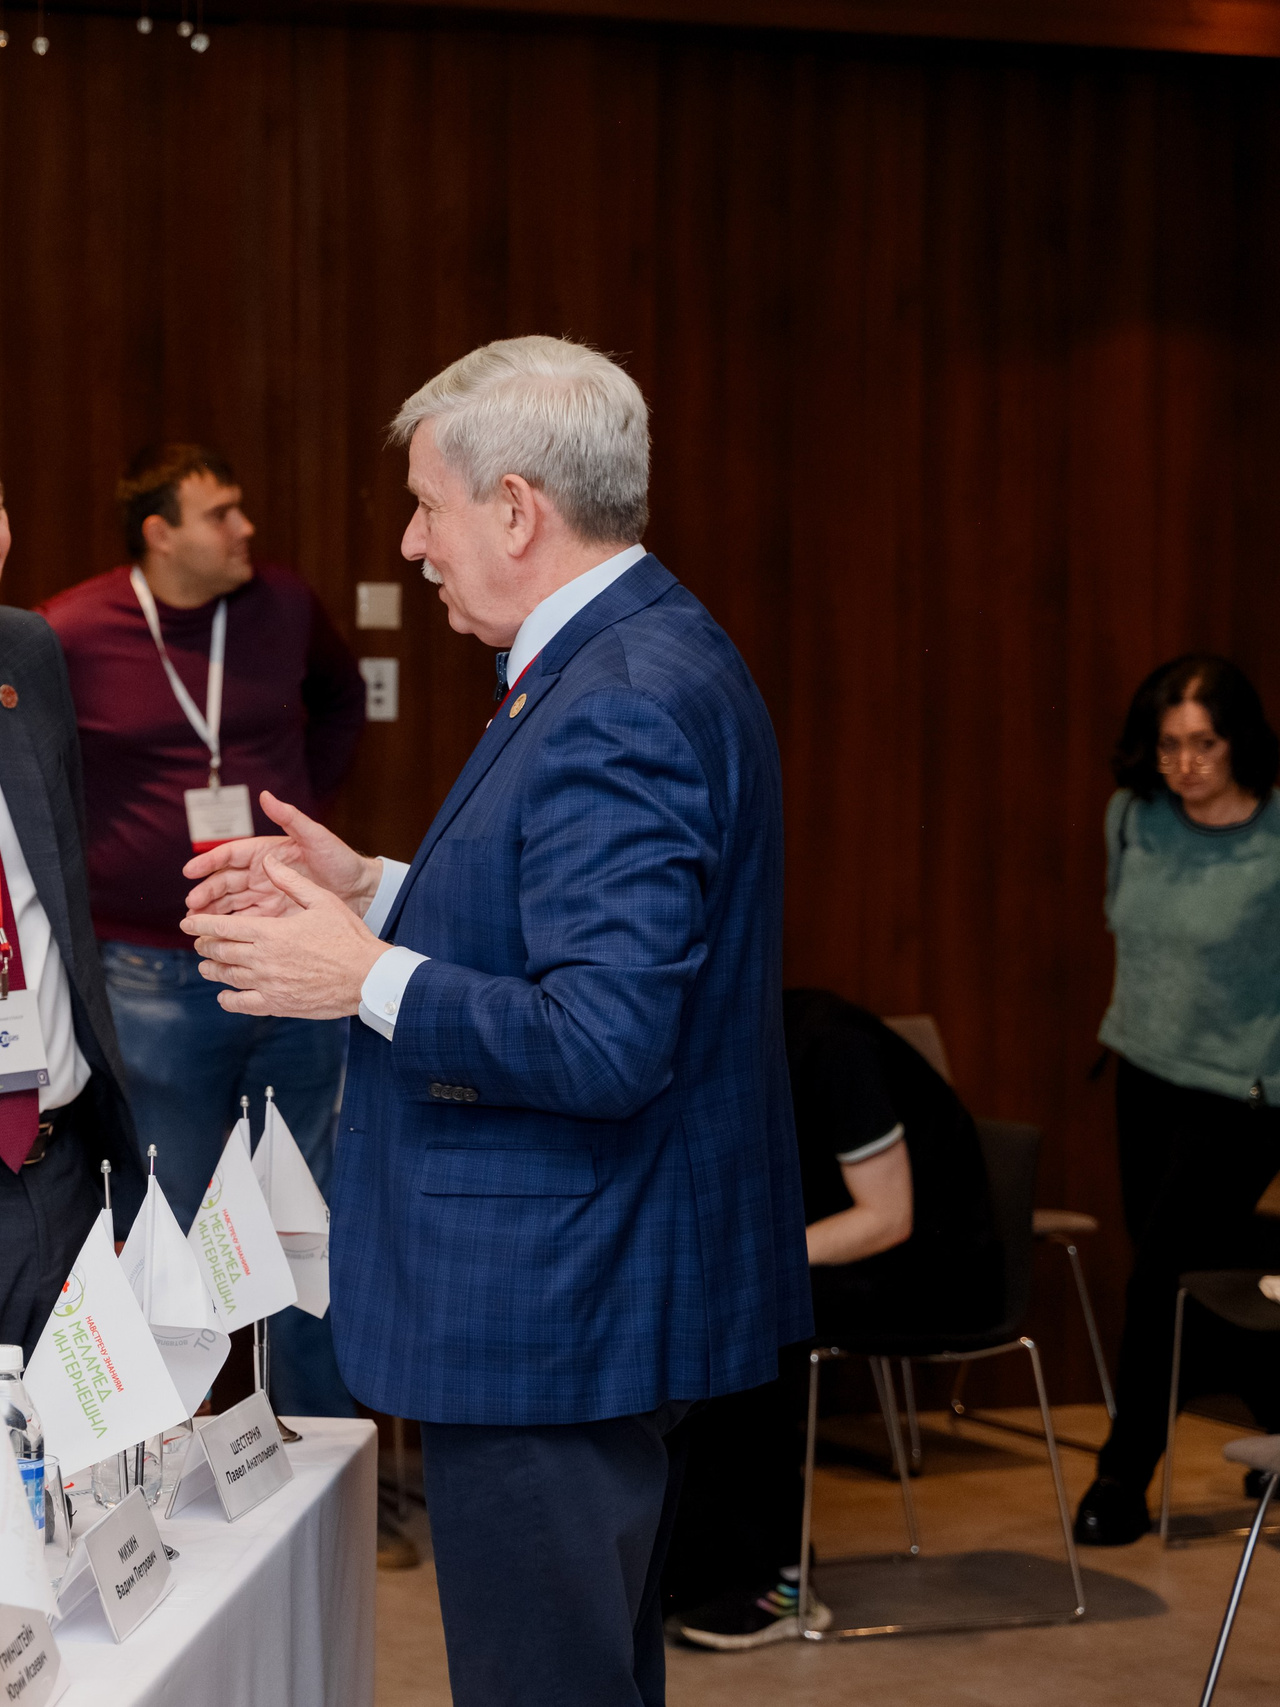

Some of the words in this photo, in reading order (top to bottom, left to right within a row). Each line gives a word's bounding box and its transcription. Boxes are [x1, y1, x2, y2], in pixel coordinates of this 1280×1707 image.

[198, 1219, 237, 1315] ИНТЕРНЕШНЛ
[209, 1212, 241, 1284] МЕЛАМЕД
[52, 1328, 108, 1439] ИНТЕРНЕШНЛ
[68, 1320, 113, 1403] МЕЛАМЕД
[85, 1315, 108, 1356] НАВСТРЕЧУ
[103, 1356, 124, 1392] ЗНАНИЯМ
[225, 1464, 247, 1485] Павел
[245, 1441, 280, 1472] Анатольевич
[229, 1426, 262, 1455] ШЕСТЕРНЯ
[115, 1573, 136, 1600] Вадим
[133, 1550, 157, 1582] Петрович
[117, 1534, 140, 1564] МИХИН
[5, 1670, 27, 1702] Юрий
[23, 1650, 48, 1682] Исаевич
